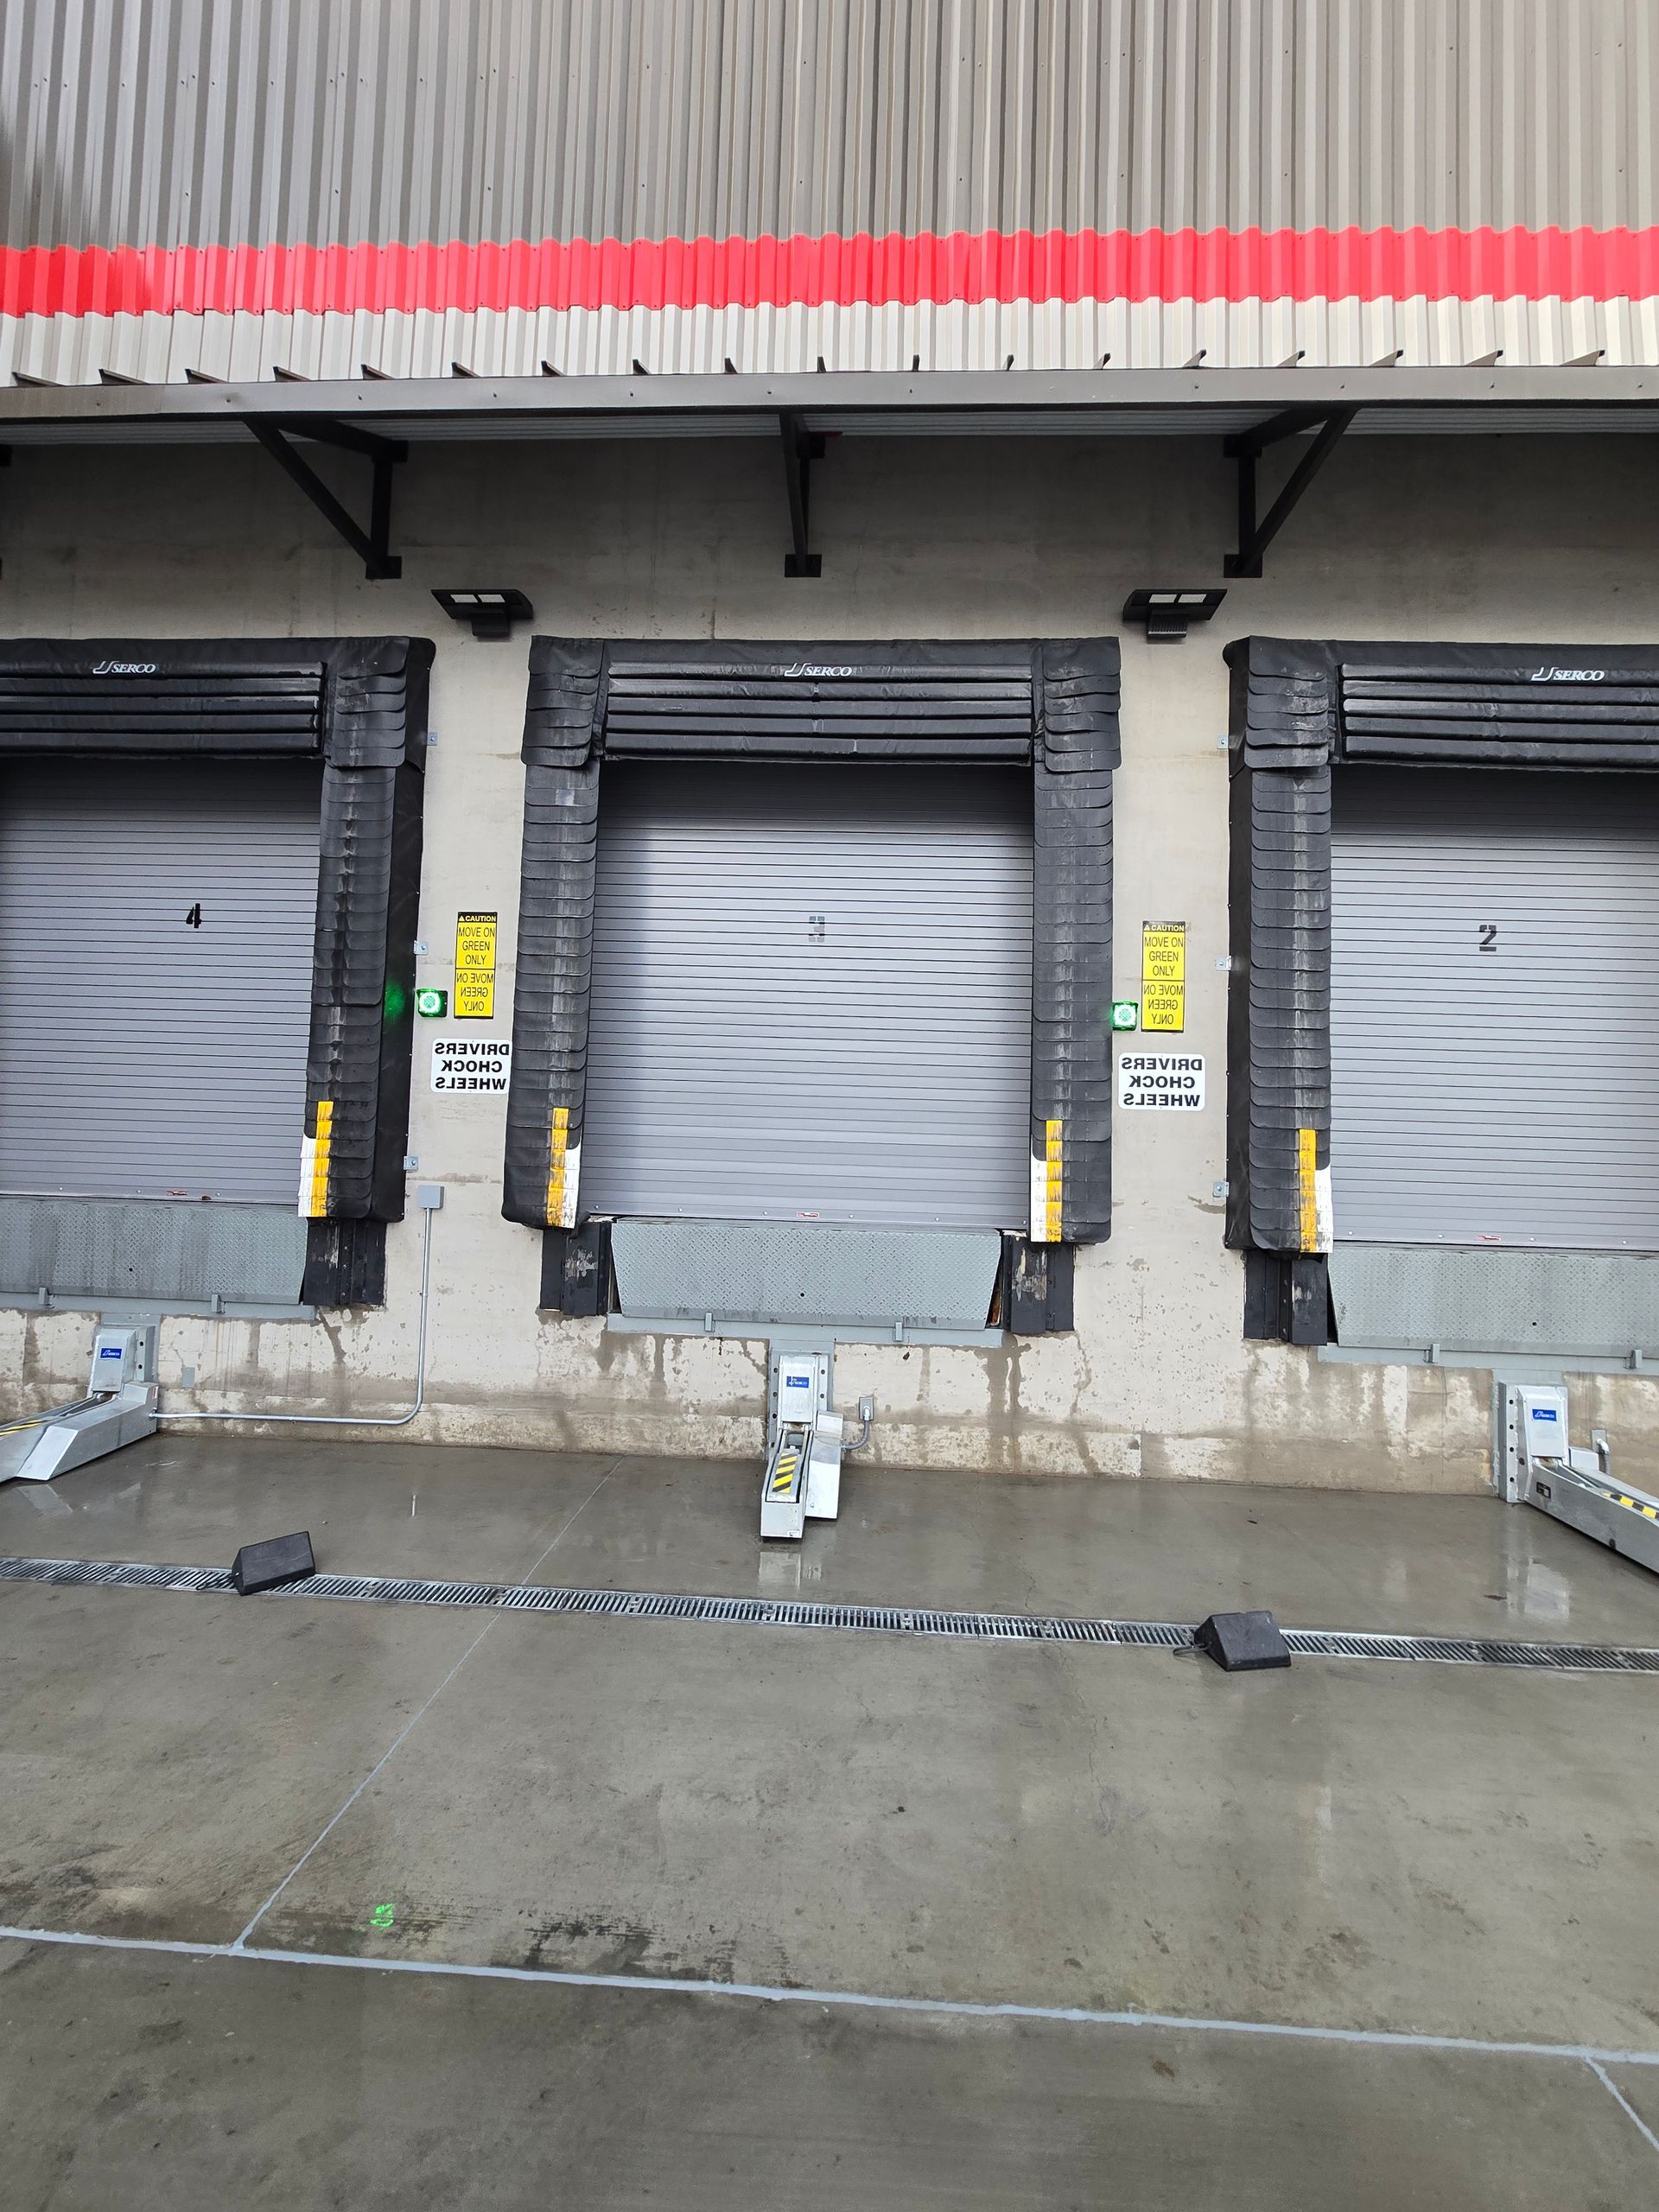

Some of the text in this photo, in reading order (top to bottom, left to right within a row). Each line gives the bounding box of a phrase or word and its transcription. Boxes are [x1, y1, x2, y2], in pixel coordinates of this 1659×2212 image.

[111, 664, 156, 674] SERCO
[804, 665, 853, 677] SERCO
[1553, 670, 1605, 682] SERCO
[186, 903, 202, 929] 4
[458, 927, 495, 938] MOVE ON
[808, 916, 825, 943] 3
[1144, 937, 1184, 947] MOVE ON
[1479, 925, 1497, 951] 2
[462, 940, 491, 951] GREEN
[465, 955, 486, 965] ONLY
[1148, 951, 1179, 962] GREEN
[1152, 965, 1175, 976] ONLY
